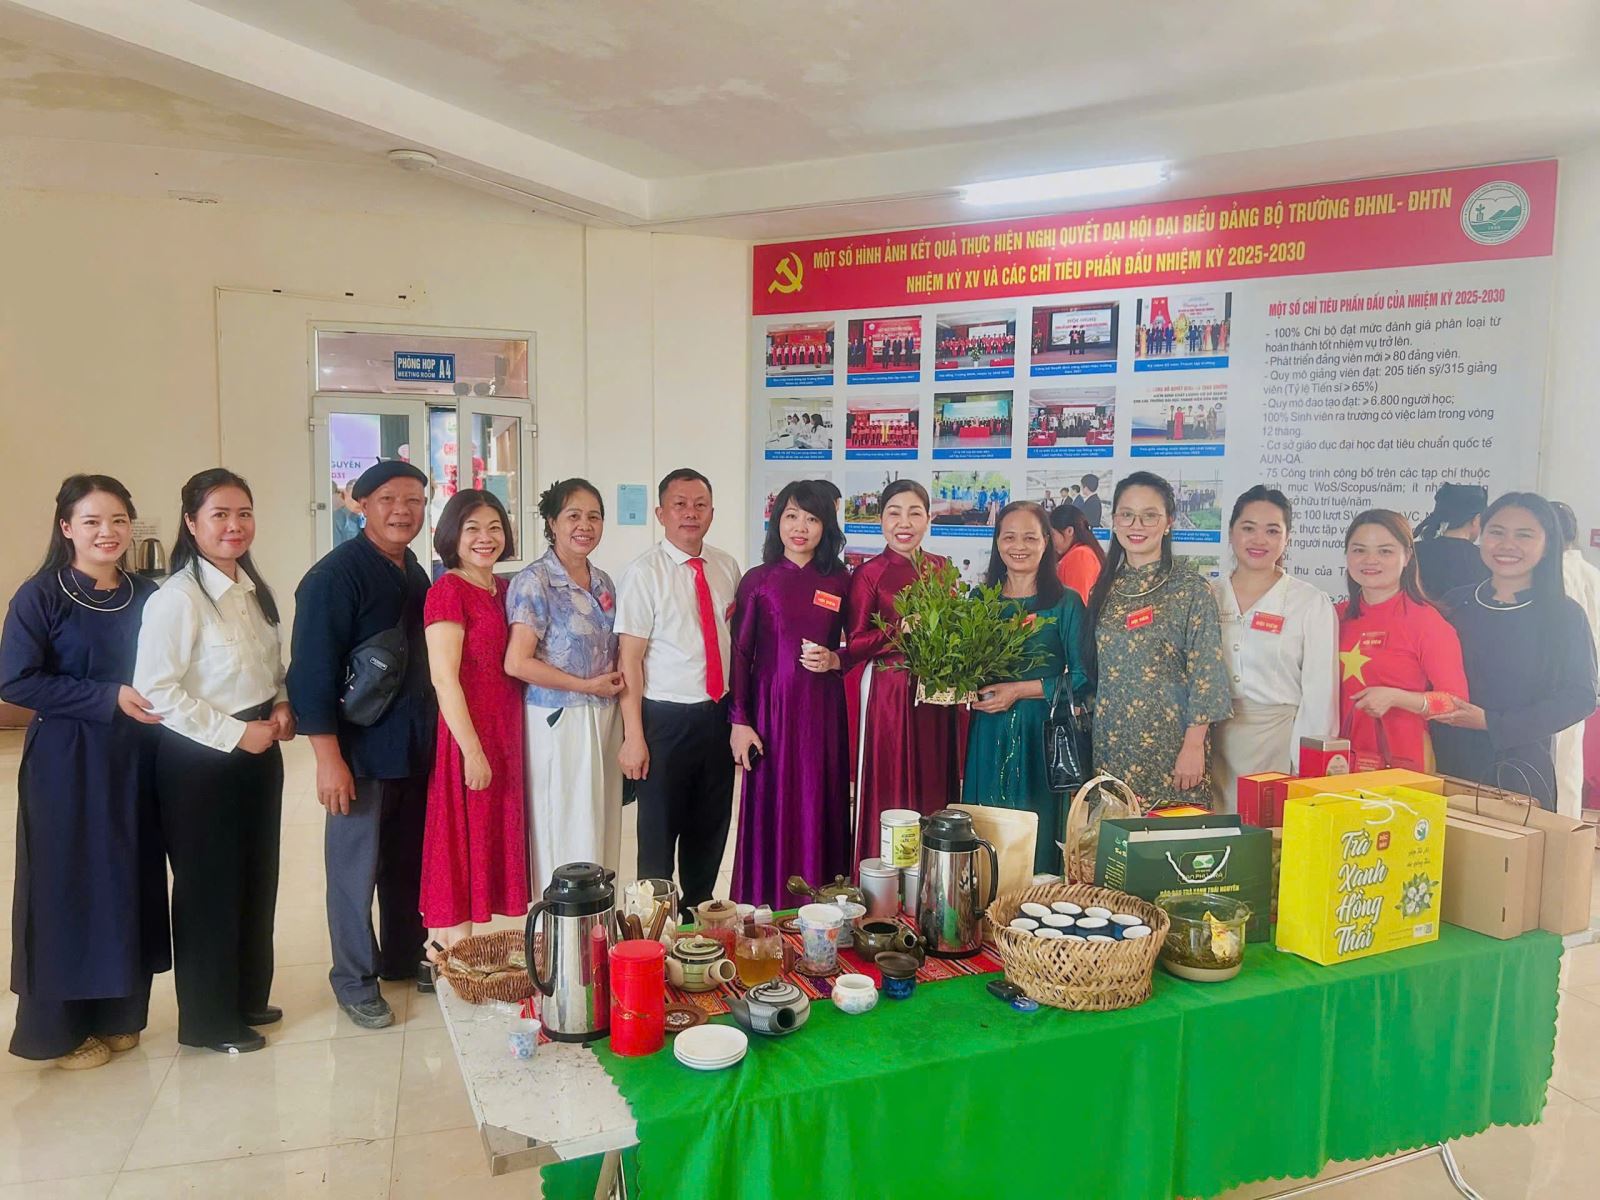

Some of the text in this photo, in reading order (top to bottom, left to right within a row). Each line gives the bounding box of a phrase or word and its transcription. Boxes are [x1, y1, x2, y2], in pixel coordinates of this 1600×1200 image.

[814, 187, 1452, 271] MỘT SỐ HÌNH ẢNH KẾT QUẢ THỰC HIỆN NGHỊ QUYẾT ĐẠI HỘI ĐẠI BIỂU ĐẢNG BỘ TRƯỜNG ĐHNL- ĐHTN
[906, 241, 1306, 294] NHIỆM KỲ XV VÀ CÁC CHỈ TIÊU PHẤN ĐẤU NHIỆM KỲ 2025-2030
[398, 355, 451, 379] PHÒNG HỌP A4
[398, 370, 420, 378] MEETING
[331, 460, 361, 469] GUYÊN
[1341, 828, 1372, 860] Trà
[1338, 858, 1388, 893] Xanh
[1336, 889, 1385, 924] Hồng
[1334, 923, 1375, 956] Thái
